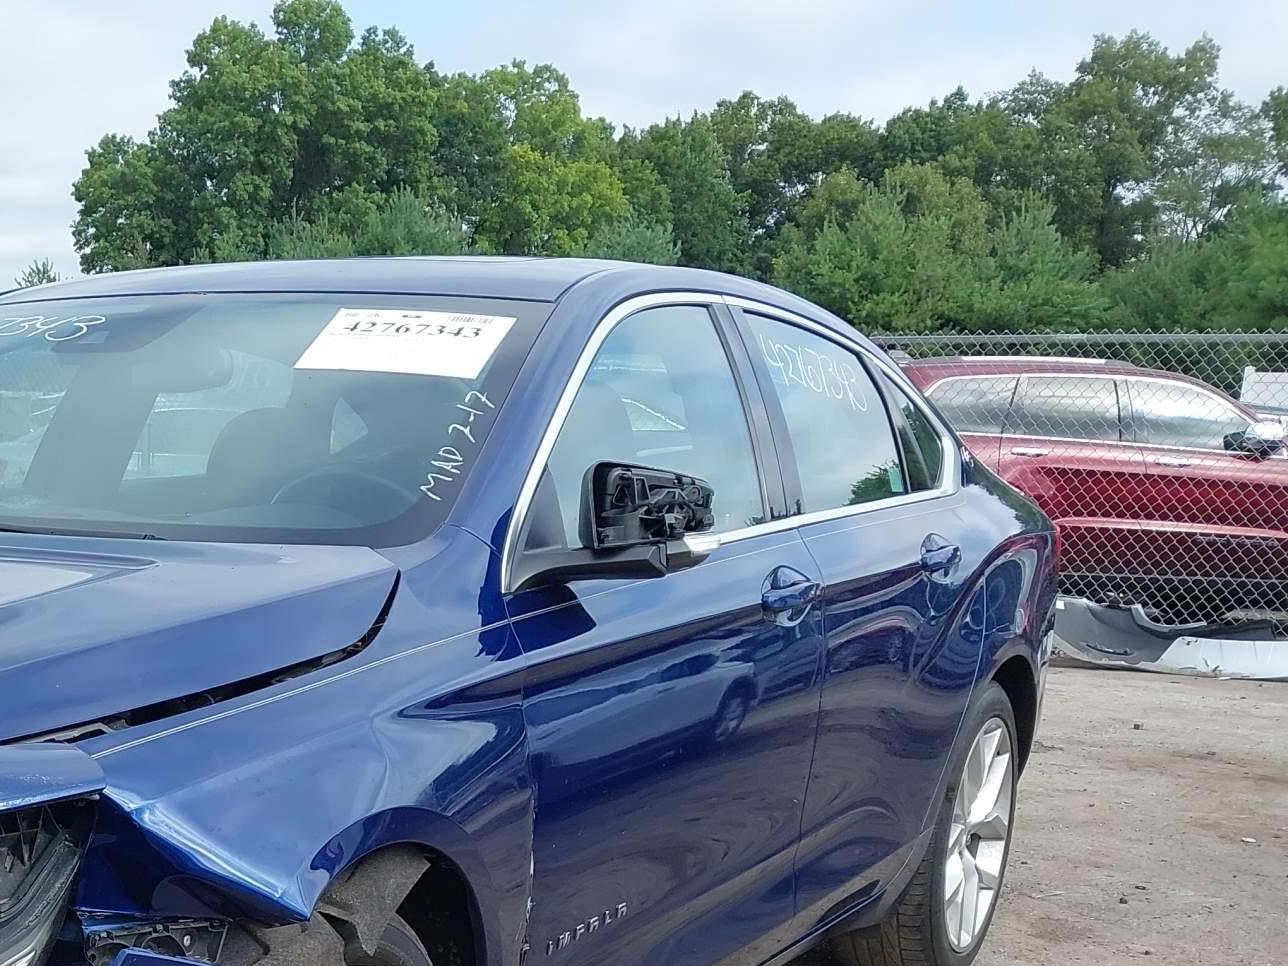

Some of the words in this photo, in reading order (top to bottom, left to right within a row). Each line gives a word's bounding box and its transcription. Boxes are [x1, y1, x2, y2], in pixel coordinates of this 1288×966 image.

[343, 321, 482, 339] 42767343
[419, 446, 464, 501] MAD
[448, 391, 495, 443] 2-17
[546, 901, 627, 956] IMPALA
